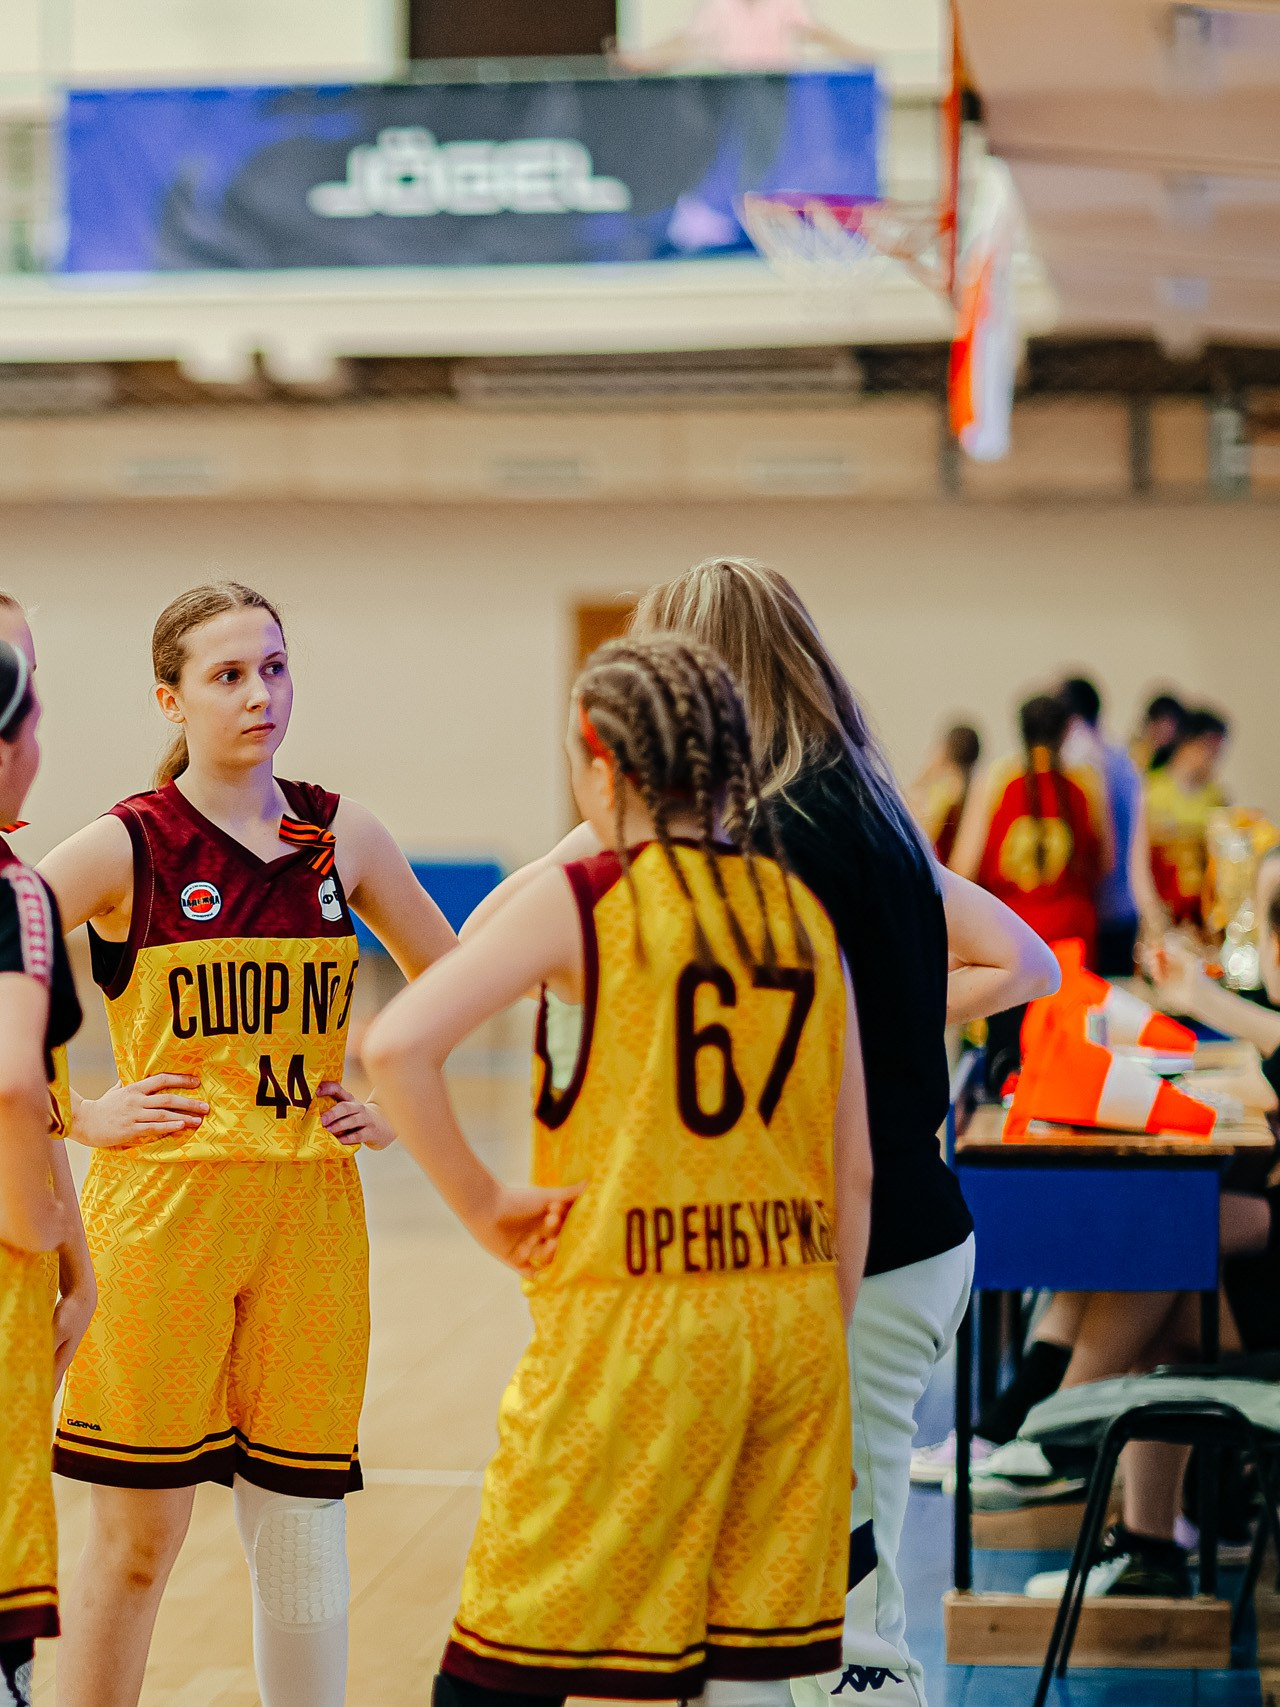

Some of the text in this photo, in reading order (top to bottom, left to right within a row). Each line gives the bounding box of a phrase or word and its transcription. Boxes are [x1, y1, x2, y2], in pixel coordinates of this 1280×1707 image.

[306, 126, 632, 217] JÖGEL
[168, 961, 289, 1039] СШОР
[256, 1055, 314, 1120] 44
[676, 961, 816, 1138] 67
